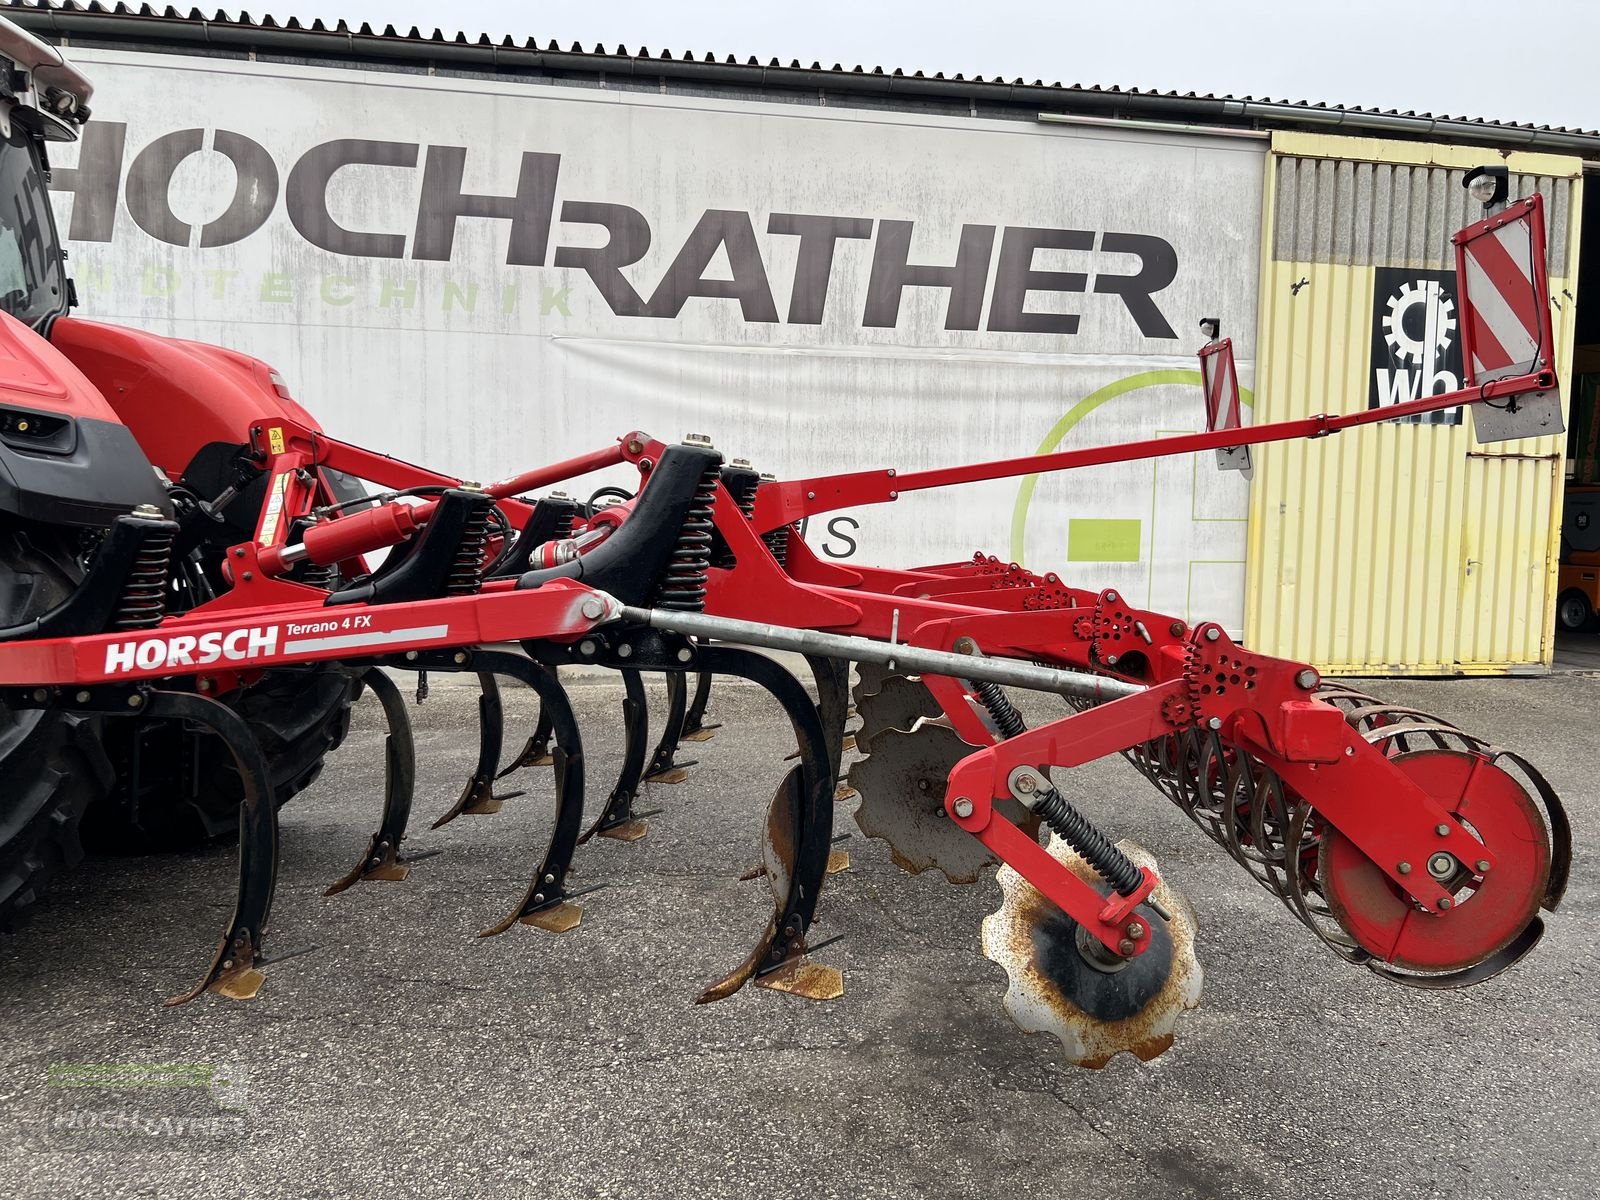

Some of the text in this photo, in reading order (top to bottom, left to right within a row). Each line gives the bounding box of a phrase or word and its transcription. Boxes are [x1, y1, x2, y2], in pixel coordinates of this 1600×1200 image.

[47, 120, 1178, 339] HOCHRATHER
[77, 262, 573, 317] NDTECHNIK
[104, 615, 372, 674] HORSCH Terrano 4 FX
